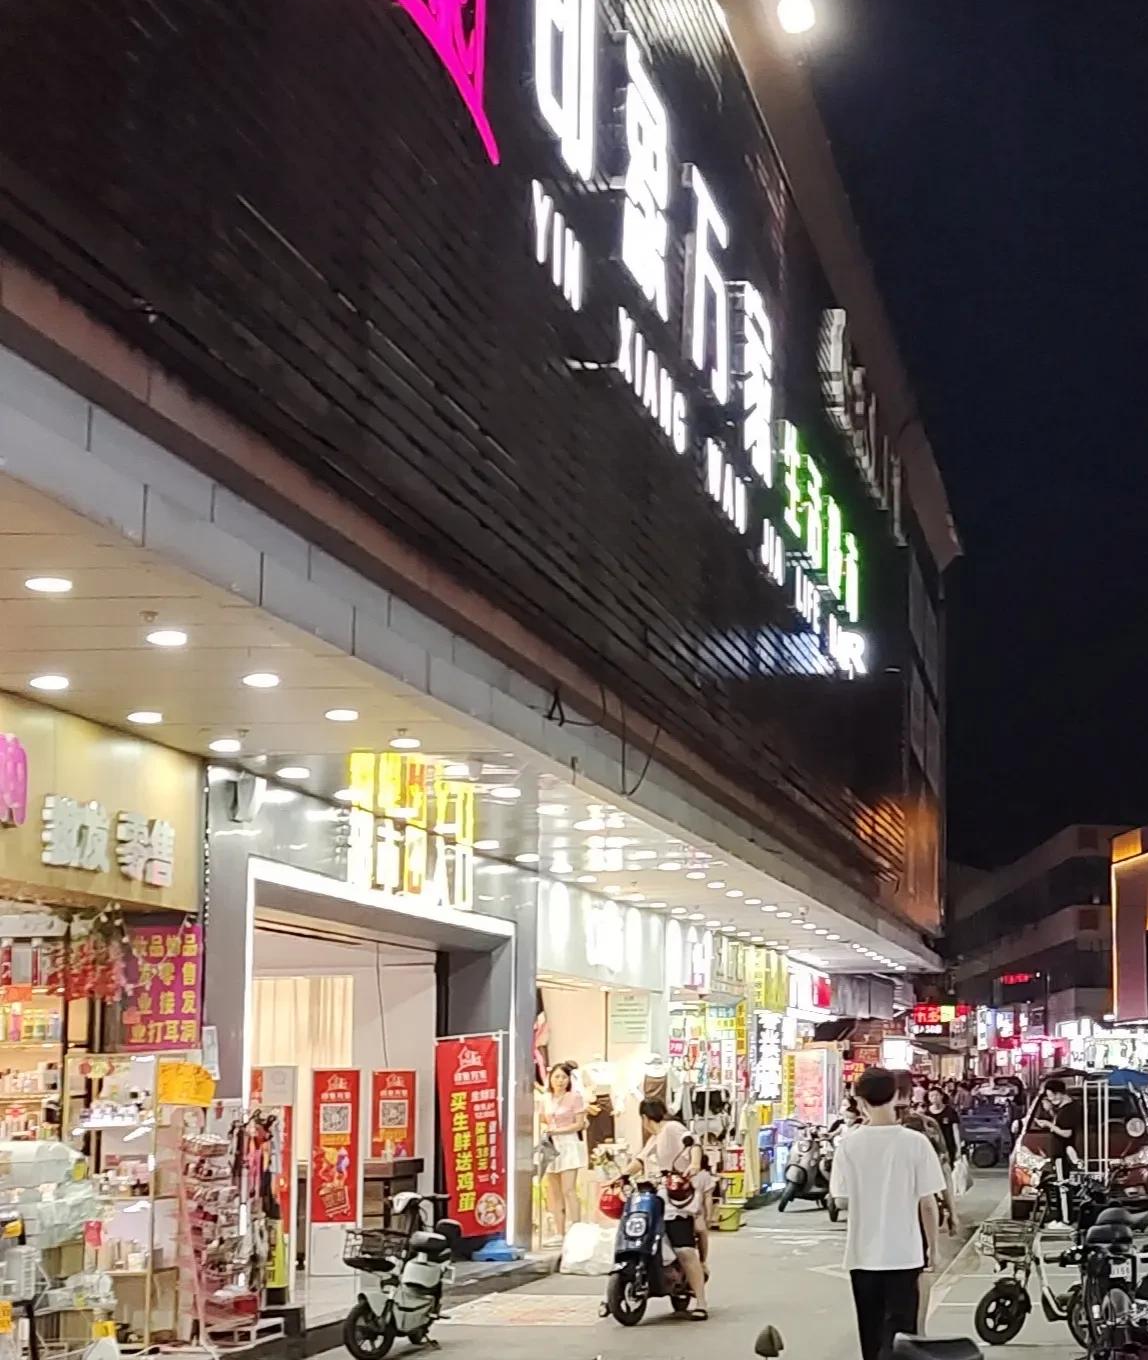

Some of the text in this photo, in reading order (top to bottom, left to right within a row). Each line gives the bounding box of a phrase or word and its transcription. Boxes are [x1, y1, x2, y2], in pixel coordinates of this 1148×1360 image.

[530, 178, 584, 311] YIN
[617, 306, 687, 454] XIANG
[450, 1091, 477, 1213] 买生鲜送鸡蛋
